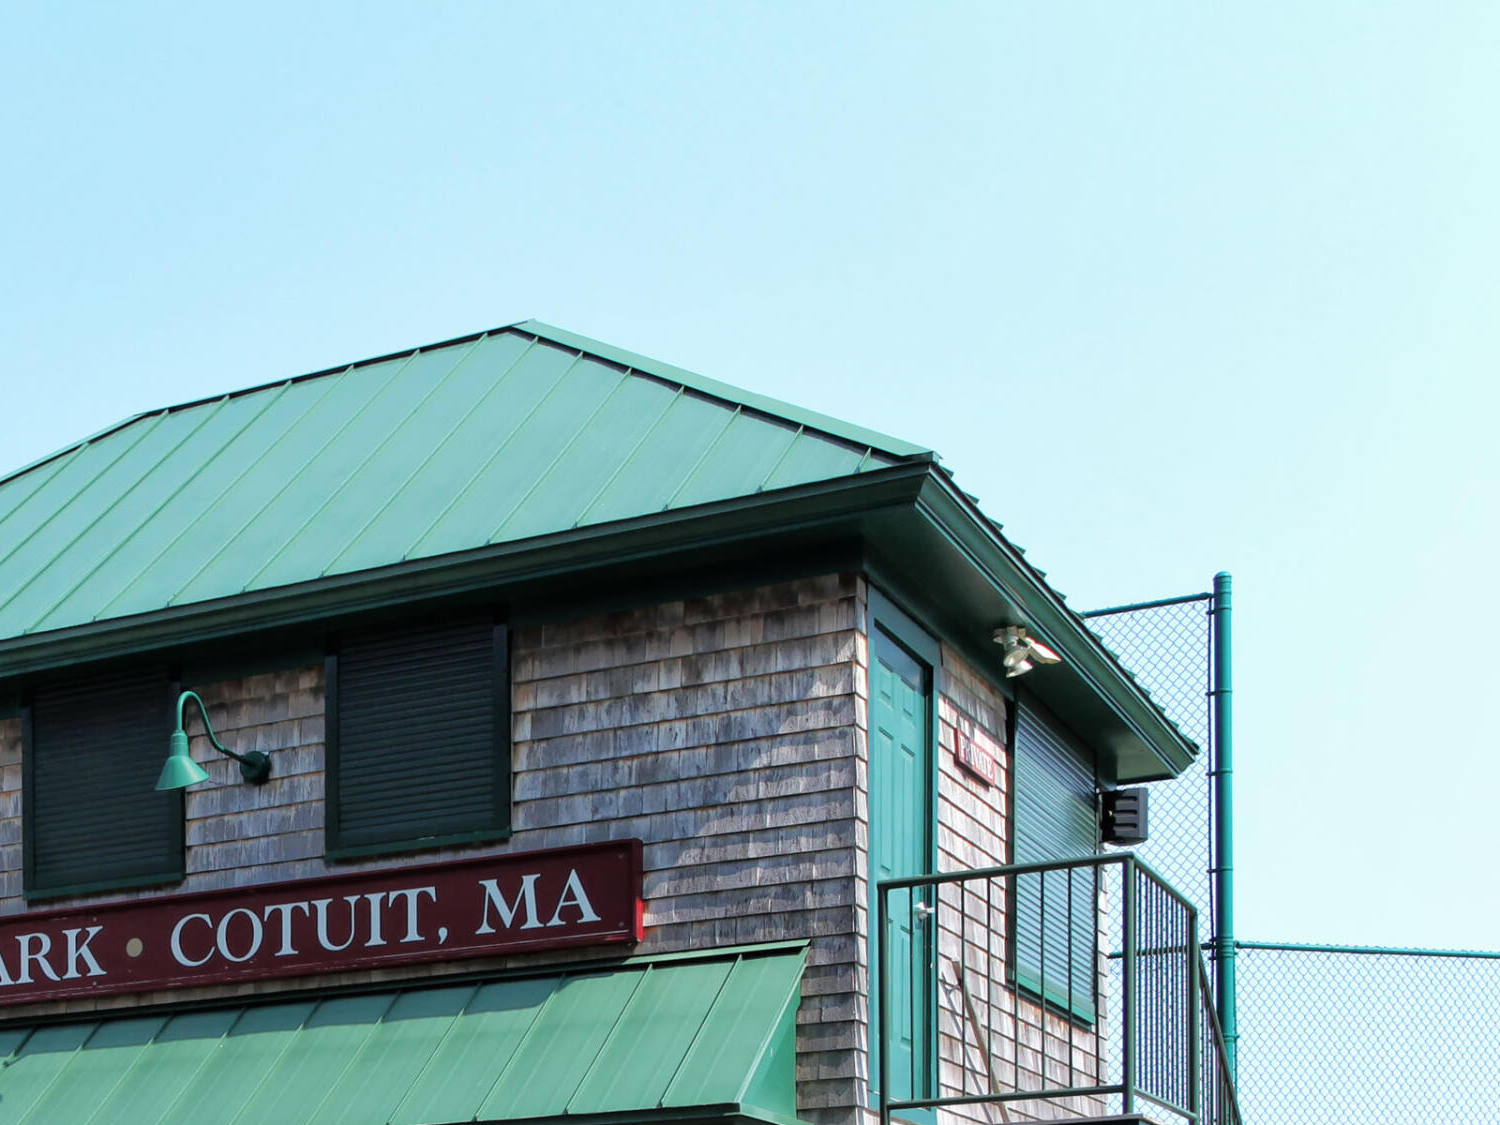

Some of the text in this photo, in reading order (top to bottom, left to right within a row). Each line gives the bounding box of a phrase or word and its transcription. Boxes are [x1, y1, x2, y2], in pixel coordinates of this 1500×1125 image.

[959, 734, 994, 780] PRIVATE
[170, 886, 449, 967] COTUIT,
[475, 868, 602, 935] MA
